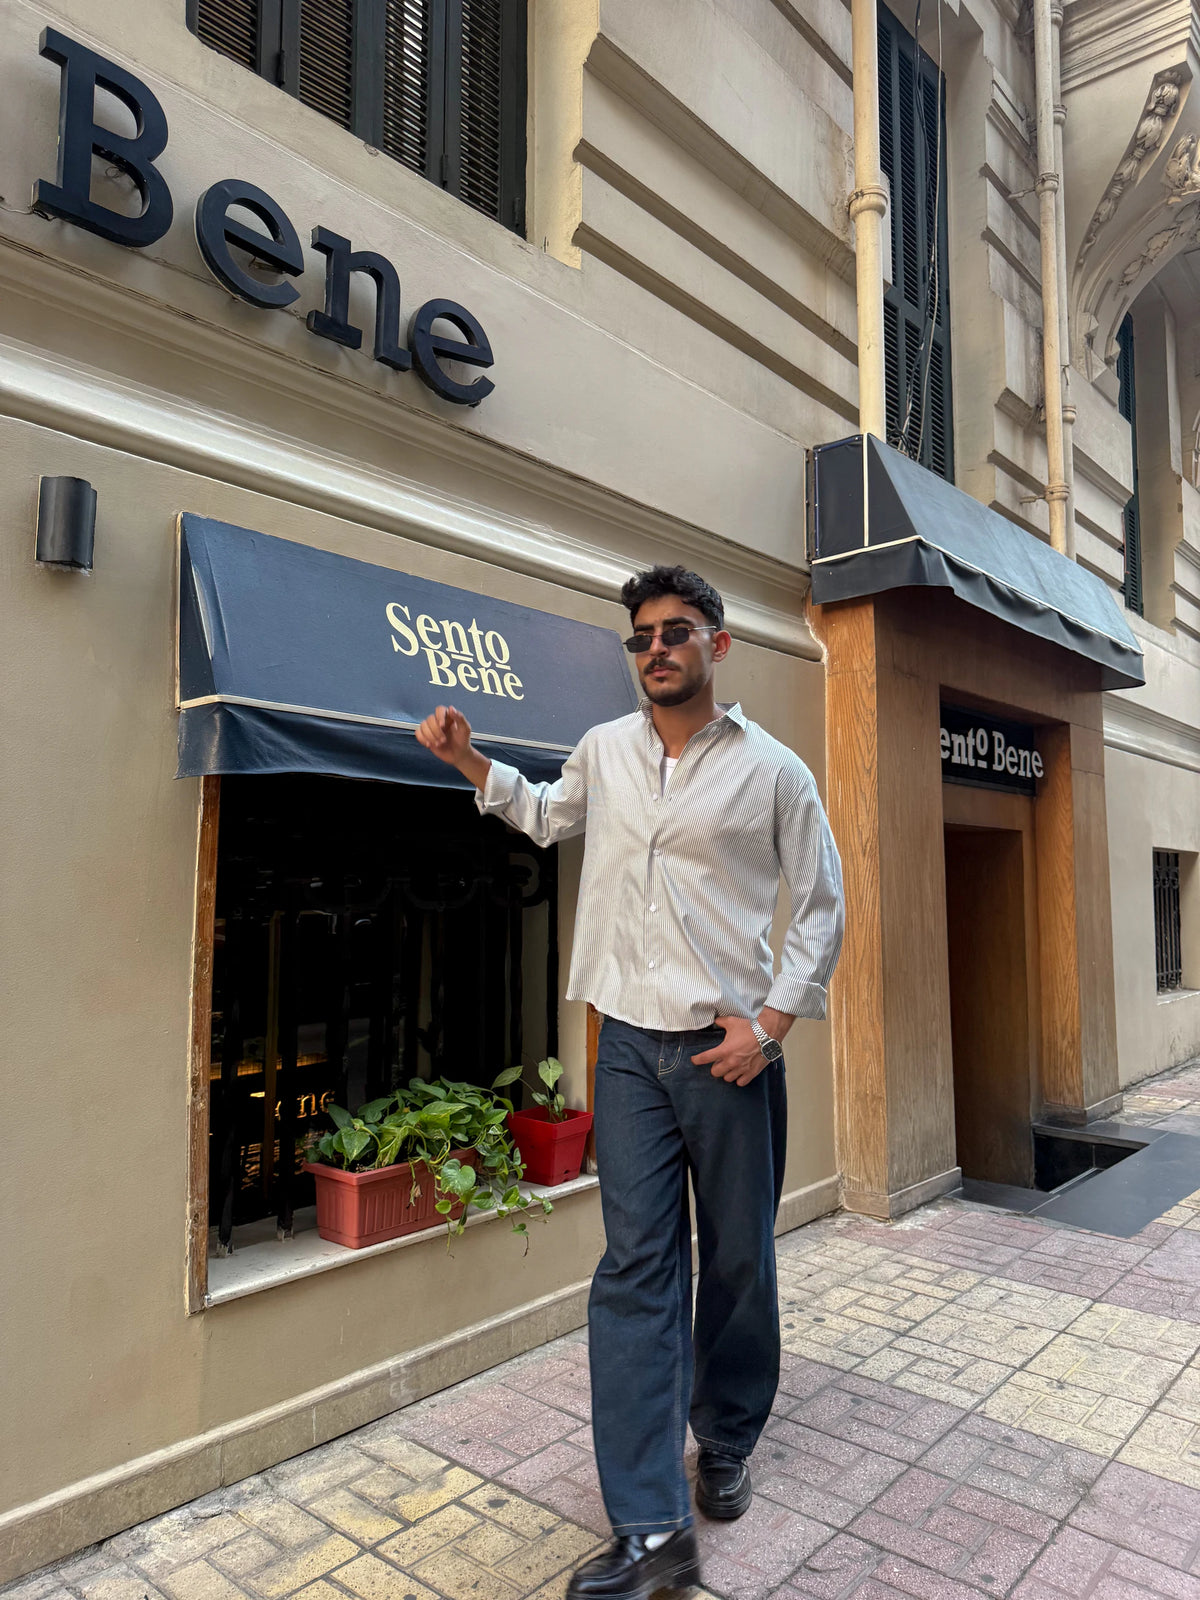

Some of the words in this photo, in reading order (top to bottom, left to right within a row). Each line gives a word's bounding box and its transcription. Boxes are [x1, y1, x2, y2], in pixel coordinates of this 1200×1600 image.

[32, 26, 496, 405] Bene
[385, 602, 512, 671] Sento
[420, 646, 525, 701] Bene
[940, 727, 989, 769] ento
[992, 730, 1044, 778] Bene
